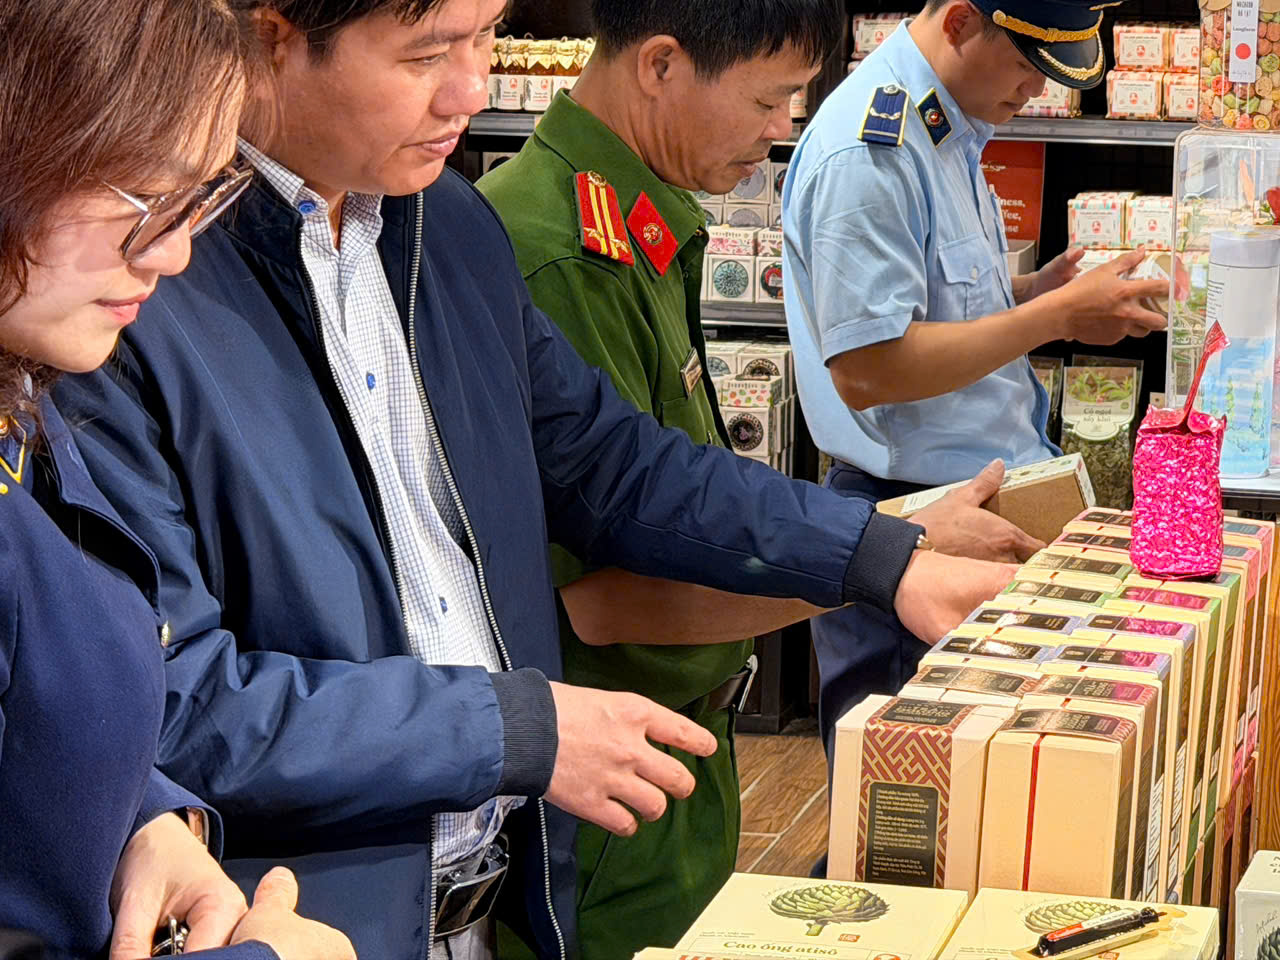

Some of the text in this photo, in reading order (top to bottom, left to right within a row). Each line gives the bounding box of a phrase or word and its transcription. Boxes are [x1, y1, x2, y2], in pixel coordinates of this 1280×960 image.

[723, 940, 838, 956] Cao ống atisô
